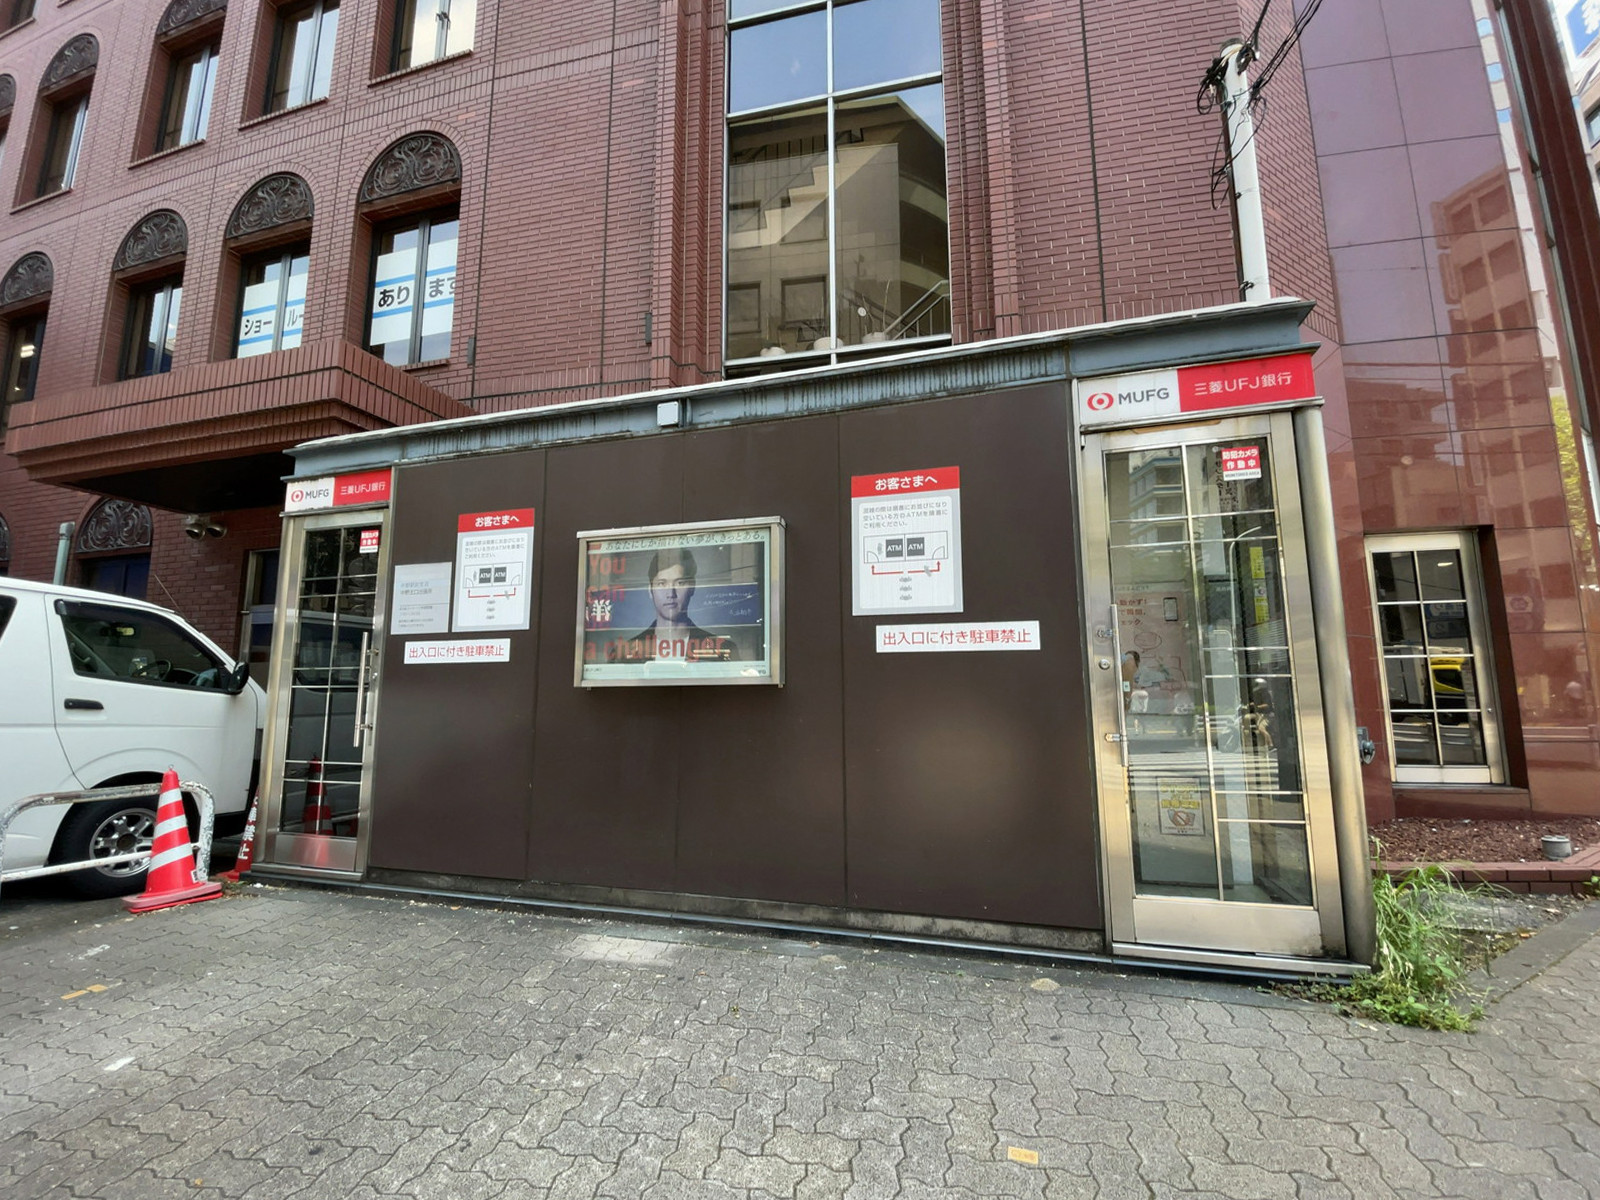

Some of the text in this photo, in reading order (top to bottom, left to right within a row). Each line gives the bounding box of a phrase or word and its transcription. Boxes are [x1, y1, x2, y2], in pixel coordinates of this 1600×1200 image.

[1118, 371, 1293, 406] MUFG 三菱UFJ銀行
[304, 480, 386, 501] MUFG 三菱UFJ銀行
[875, 475, 938, 491] お客さまへ
[475, 515, 520, 528] お客さまへ
[887, 543, 923, 552] ATM ATM
[589, 553, 626, 576] You
[587, 584, 625, 604] can
[883, 629, 1032, 646] 出入口に付き駐車禁止
[408, 645, 505, 659] 出入口に付き駐車禁止
[603, 634, 724, 662] challenger
